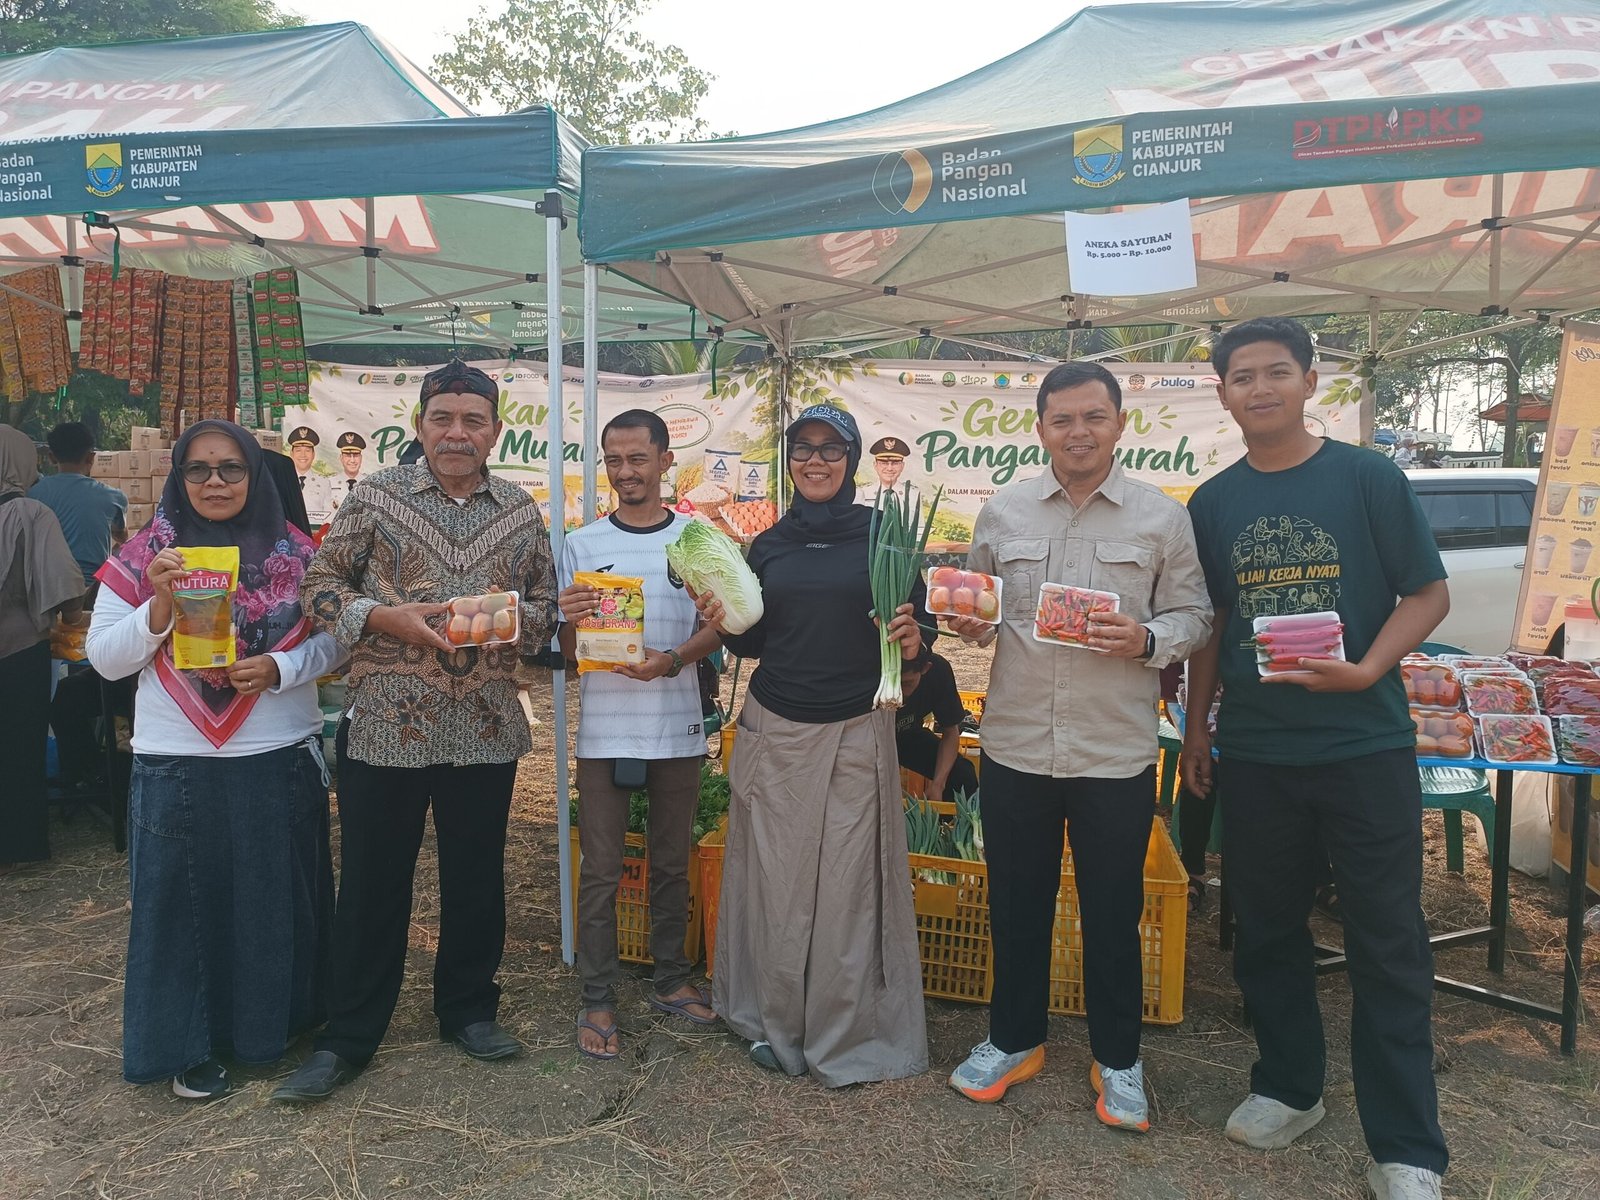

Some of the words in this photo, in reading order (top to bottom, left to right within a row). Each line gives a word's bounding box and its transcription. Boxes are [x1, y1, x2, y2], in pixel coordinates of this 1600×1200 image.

[11, 81, 224, 100] PANGAN
[1132, 121, 1234, 144] PEMERINTAH
[130, 144, 202, 160] PEMERINTAH
[942, 147, 1002, 166] Badan
[1132, 140, 1225, 161] KABUPATEN
[0, 153, 34, 168] adan
[131, 160, 198, 175] KABUPATEN
[1132, 158, 1202, 177] CIANJUR
[0, 171, 42, 186] angan
[942, 162, 1013, 181] Pangan
[131, 175, 180, 189] CIANJUR
[942, 178, 1027, 203] Nasional
[1084, 240, 1119, 249] ANEKA
[1121, 232, 1172, 247] SAYURAN
[1087, 250, 1099, 258] Rp.
[1145, 245, 1172, 255] 10.000
[1161, 377, 1195, 389] bulog
[1115, 435, 1200, 476] urah
[1268, 566, 1302, 582] KERJA
[1306, 564, 1340, 579] NYATA
[580, 618, 603, 629] ROSE
[605, 618, 637, 628] BRAND
